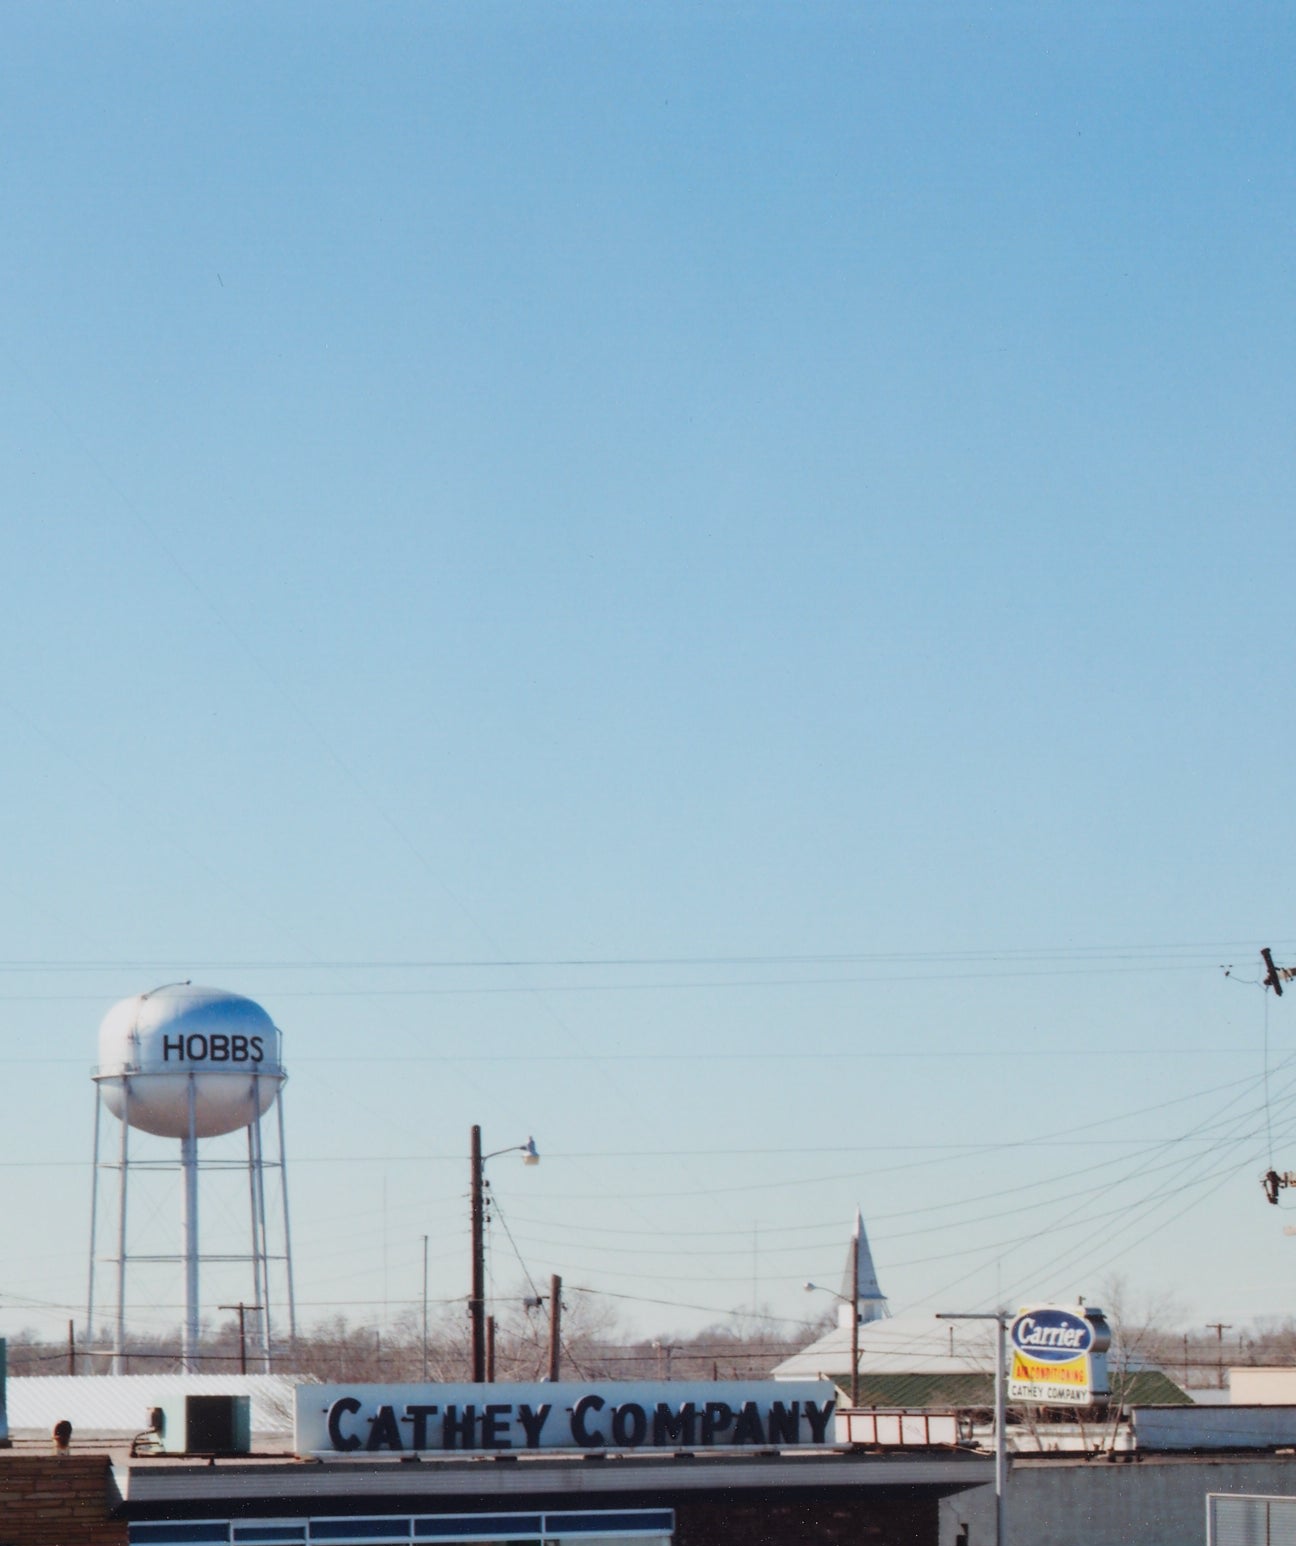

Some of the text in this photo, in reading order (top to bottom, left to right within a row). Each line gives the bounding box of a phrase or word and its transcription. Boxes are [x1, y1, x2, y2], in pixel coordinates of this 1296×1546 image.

[163, 1034, 264, 1063] HOBBS
[1018, 1317, 1086, 1347] Carrier
[1012, 1385, 1088, 1400] CATHEY COMPANY
[327, 1394, 836, 1452] CATHEY COMPANY
